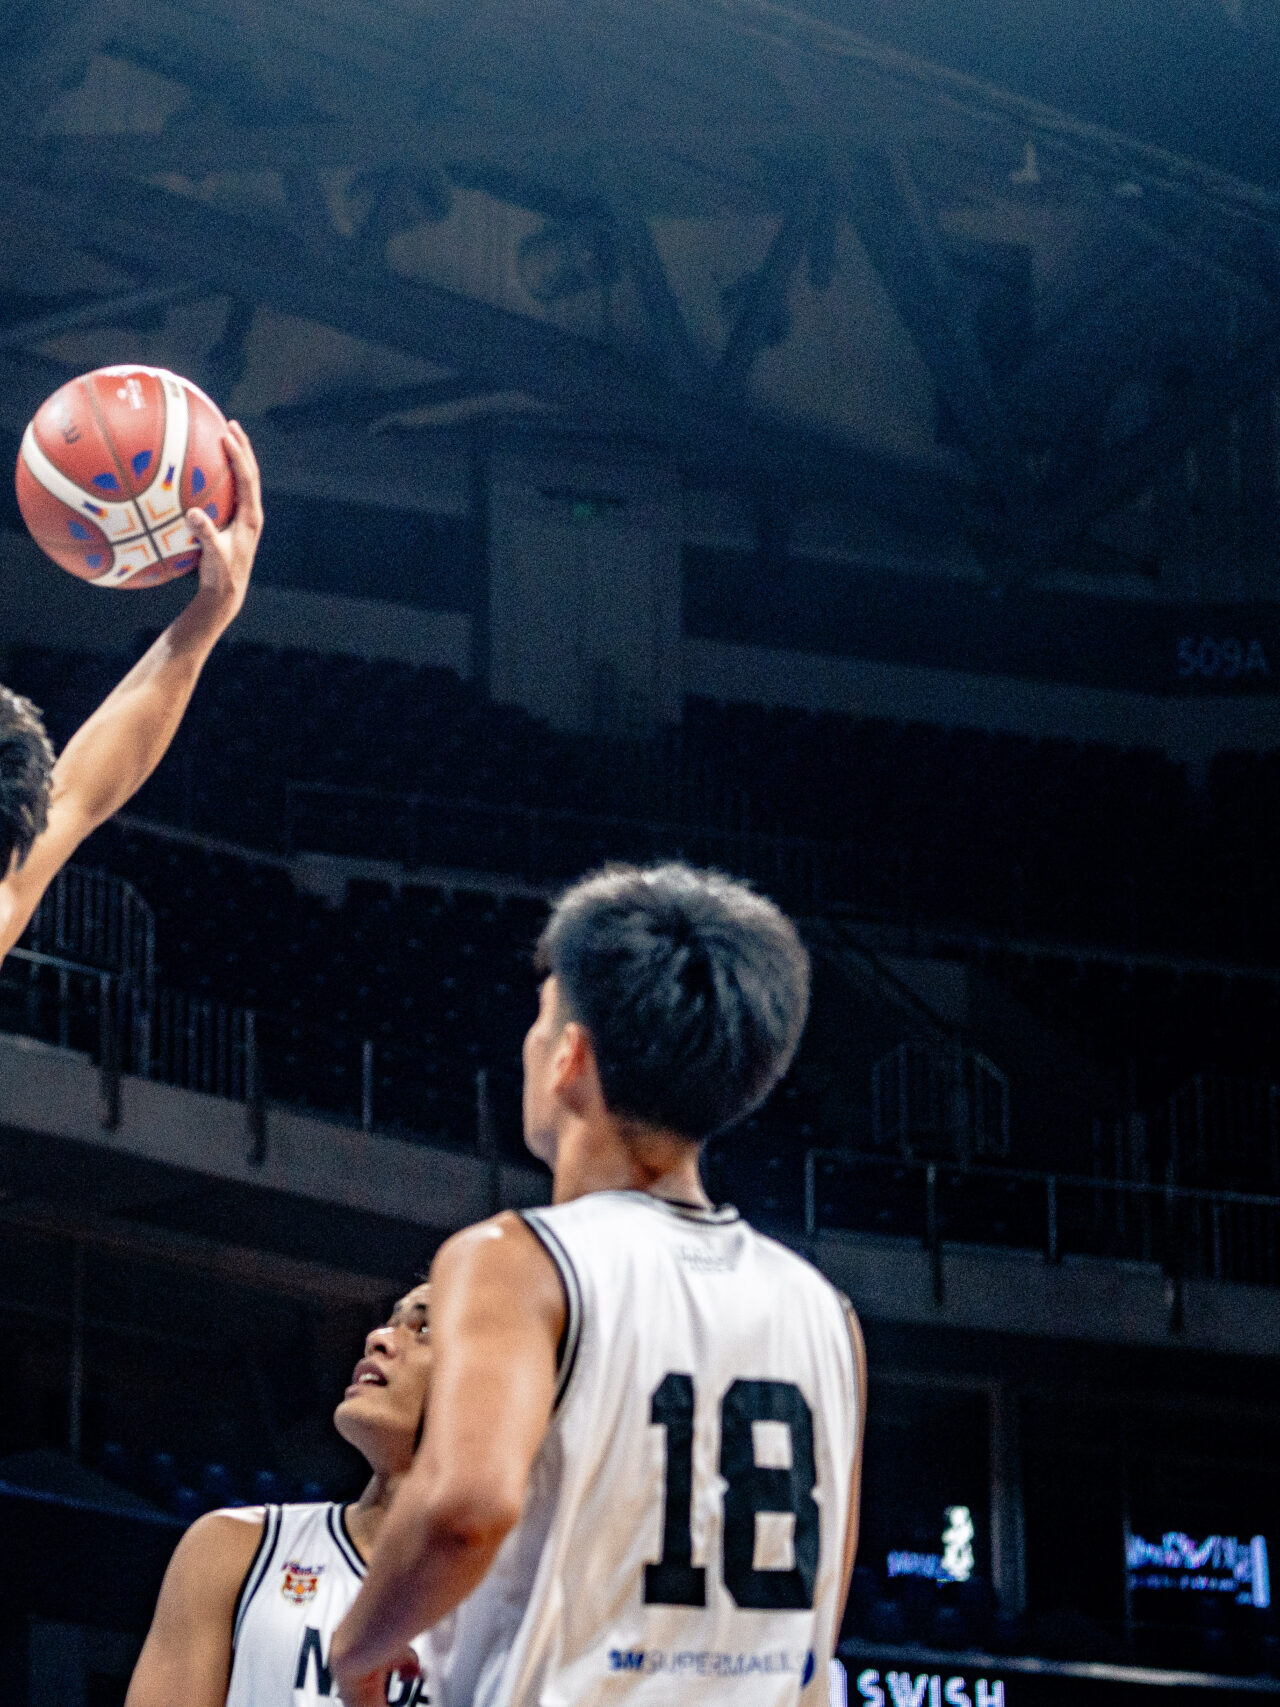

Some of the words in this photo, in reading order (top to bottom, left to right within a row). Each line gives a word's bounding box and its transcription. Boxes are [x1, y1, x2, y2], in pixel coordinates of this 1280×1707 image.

[1176, 636, 1270, 678] 509A
[644, 1372, 821, 1610] 18
[857, 1668, 1005, 1707] SWISH
